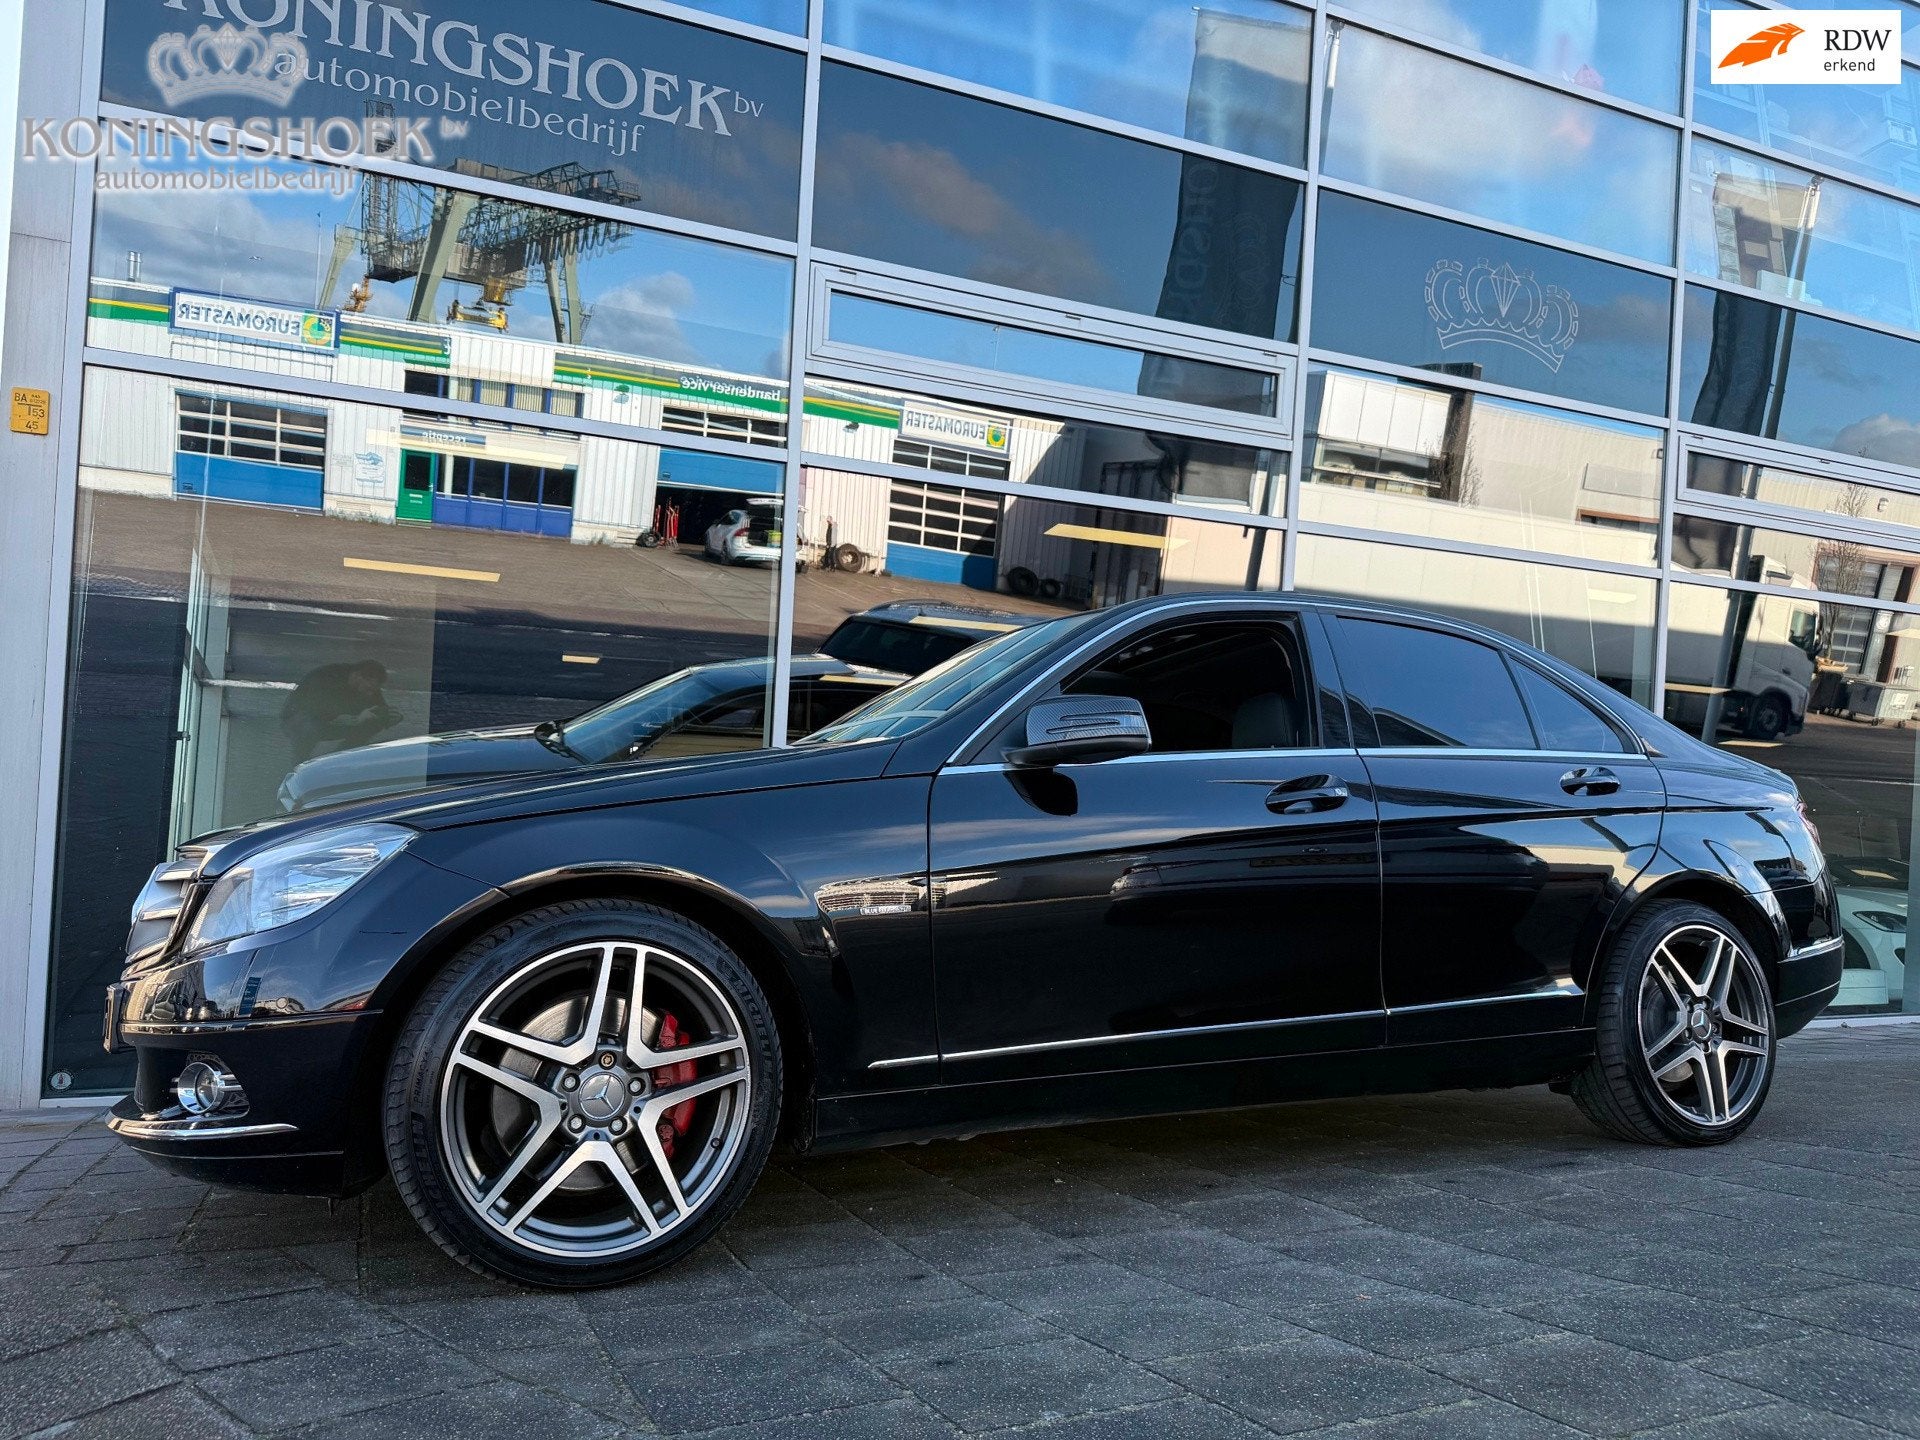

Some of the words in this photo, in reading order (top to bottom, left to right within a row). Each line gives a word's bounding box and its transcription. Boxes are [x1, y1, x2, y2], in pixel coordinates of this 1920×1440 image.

[274, 52, 645, 156] automobielbedrijf
[734, 91, 764, 117] bv
[14, 392, 28, 403] BA
